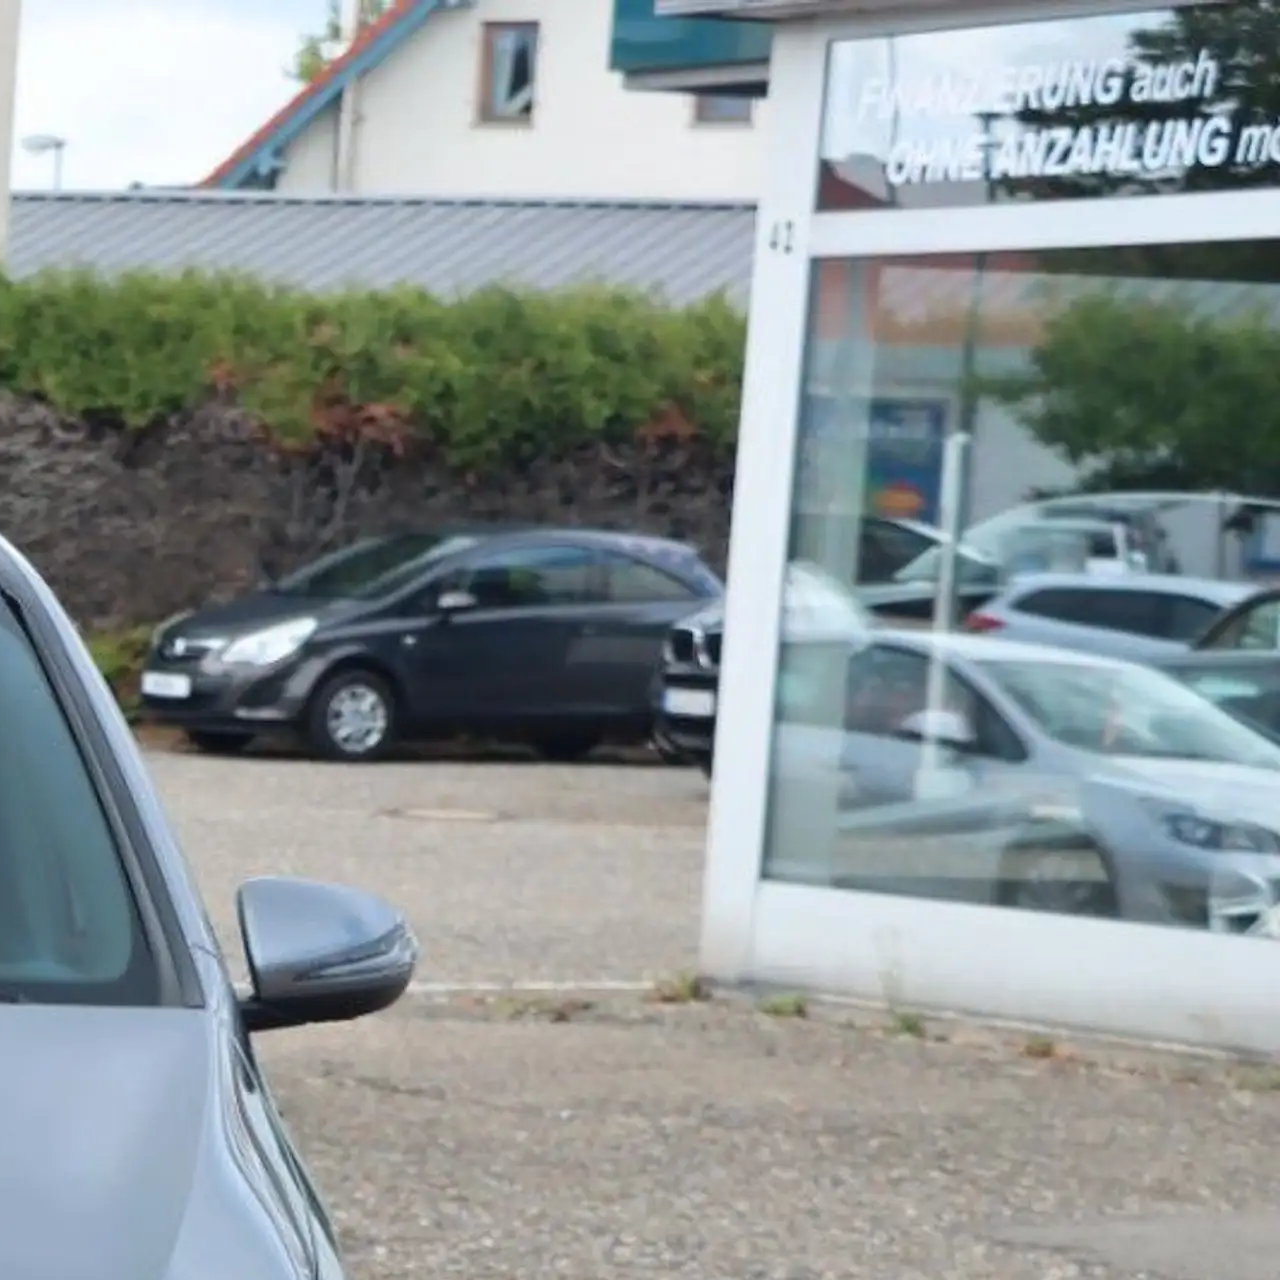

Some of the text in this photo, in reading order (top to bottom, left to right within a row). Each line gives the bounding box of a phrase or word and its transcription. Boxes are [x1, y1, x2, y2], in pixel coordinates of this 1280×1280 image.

[1128, 47, 1218, 102] auch
[885, 129, 986, 186] OHNE
[988, 114, 1232, 180] ANZAHLUNG
